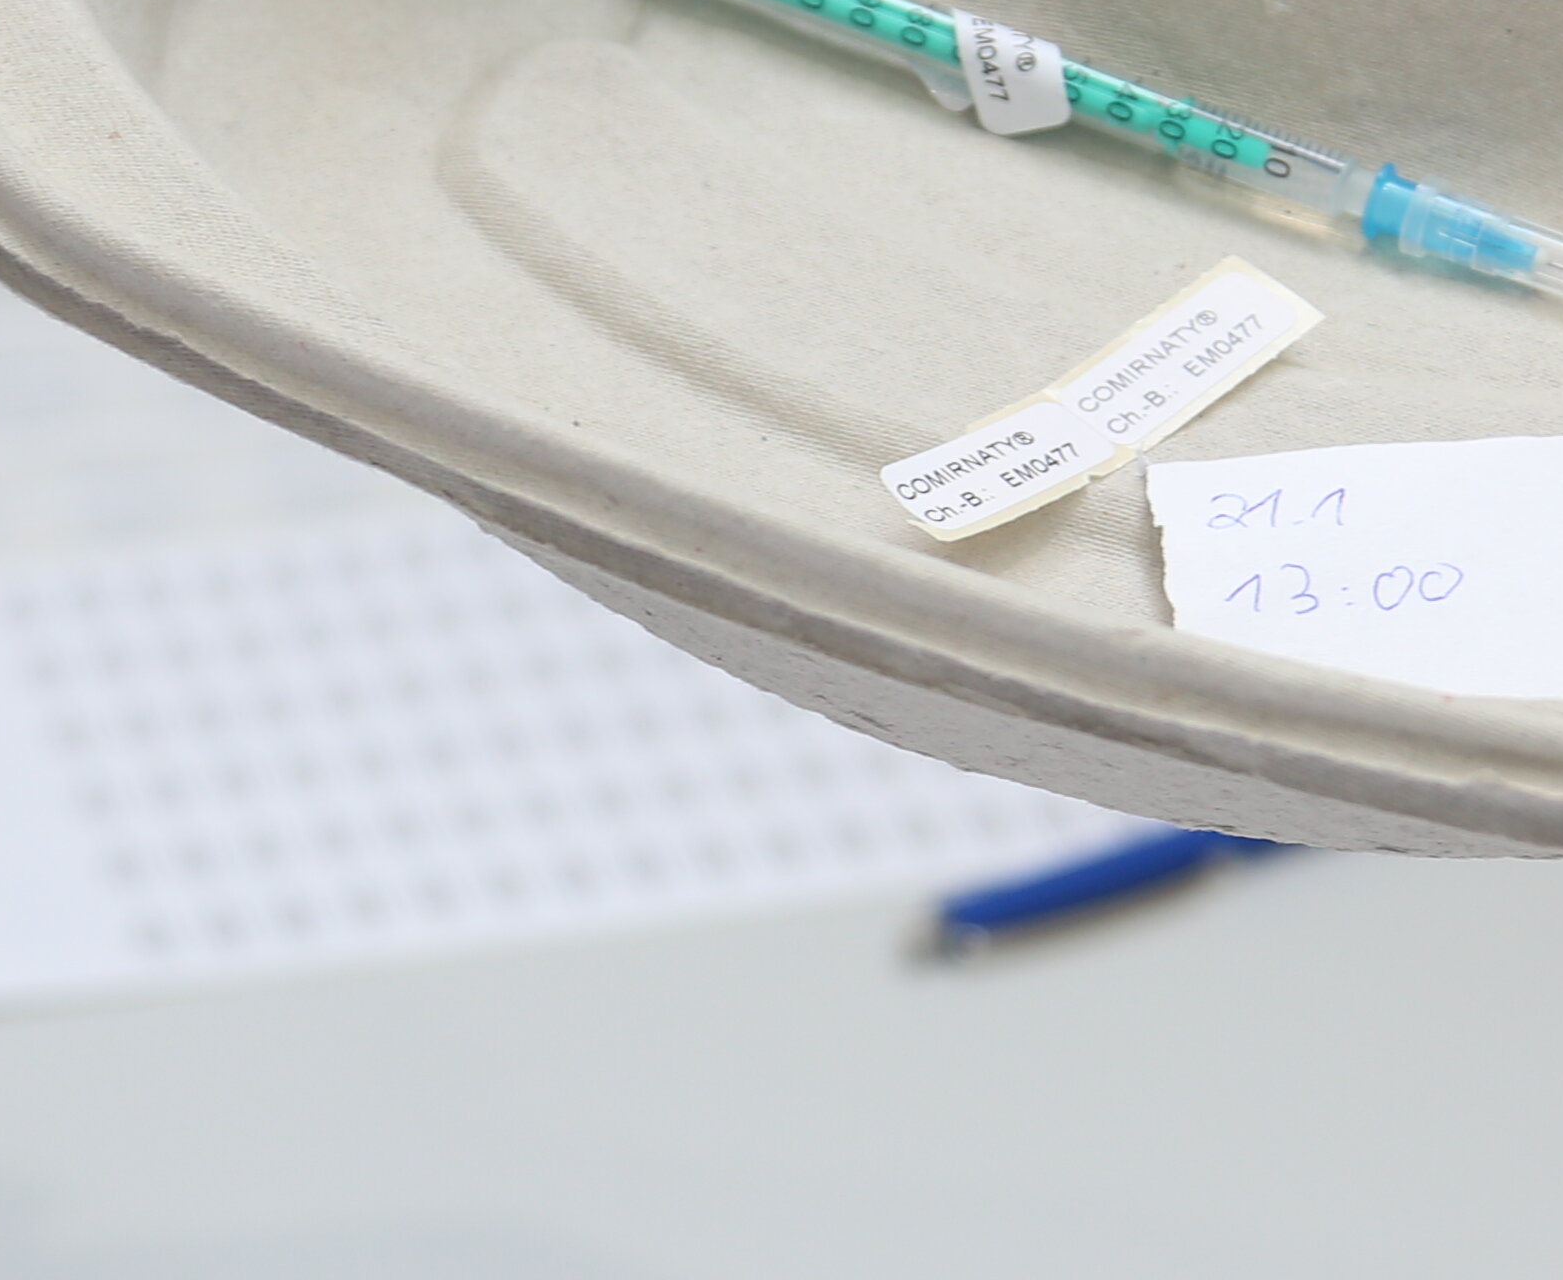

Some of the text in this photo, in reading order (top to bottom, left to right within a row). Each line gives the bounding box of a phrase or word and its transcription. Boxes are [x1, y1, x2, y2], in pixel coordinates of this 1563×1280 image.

[1210, 121, 1246, 160] 20
[1076, 307, 1219, 417] COMIRNATY®
[1180, 312, 1265, 380] EM0477
[895, 429, 1035, 503] COMIRNATY®
[998, 440, 1081, 491] EM0477
[1225, 561, 1464, 615] 13:00
